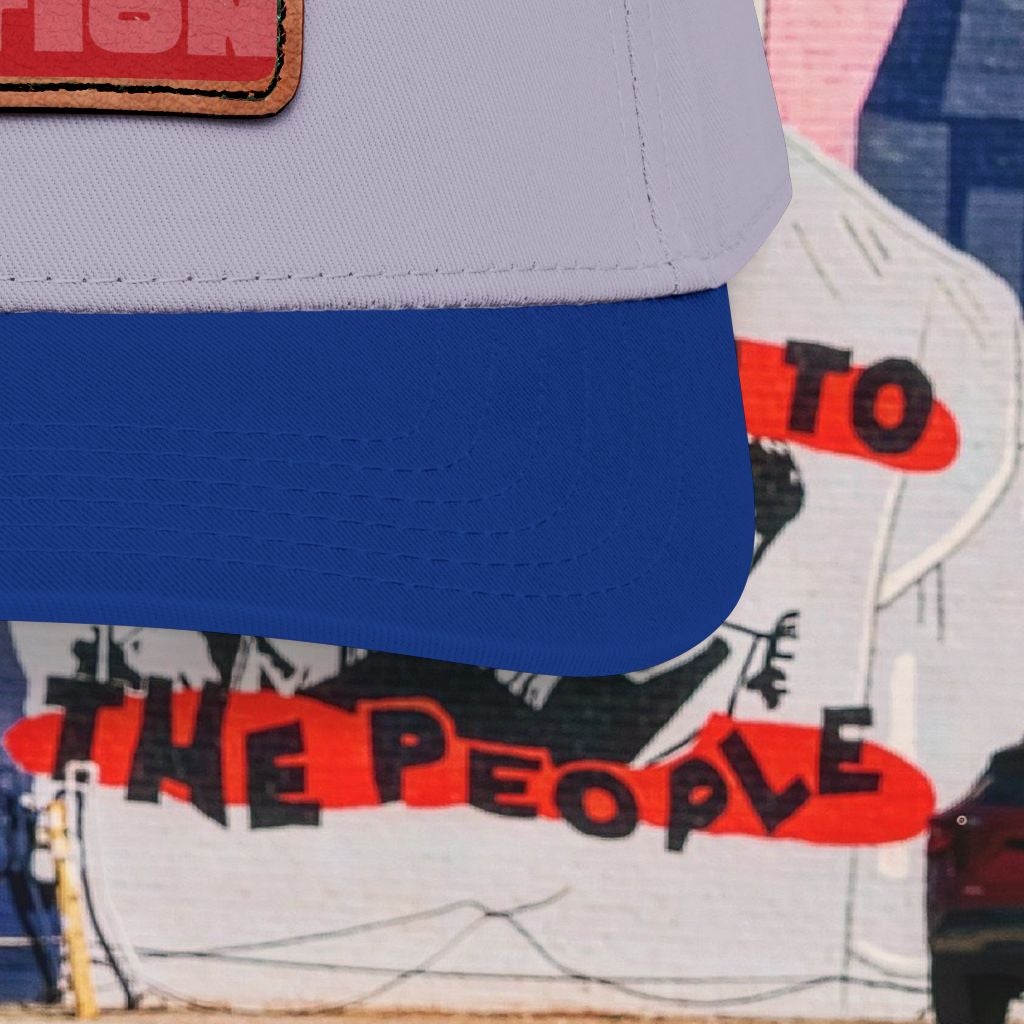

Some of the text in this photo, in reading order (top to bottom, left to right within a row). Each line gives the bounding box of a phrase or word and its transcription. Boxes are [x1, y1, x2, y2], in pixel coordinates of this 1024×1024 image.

[785, 339, 933, 455] TO
[46, 675, 882, 853] THE PEOPLE
